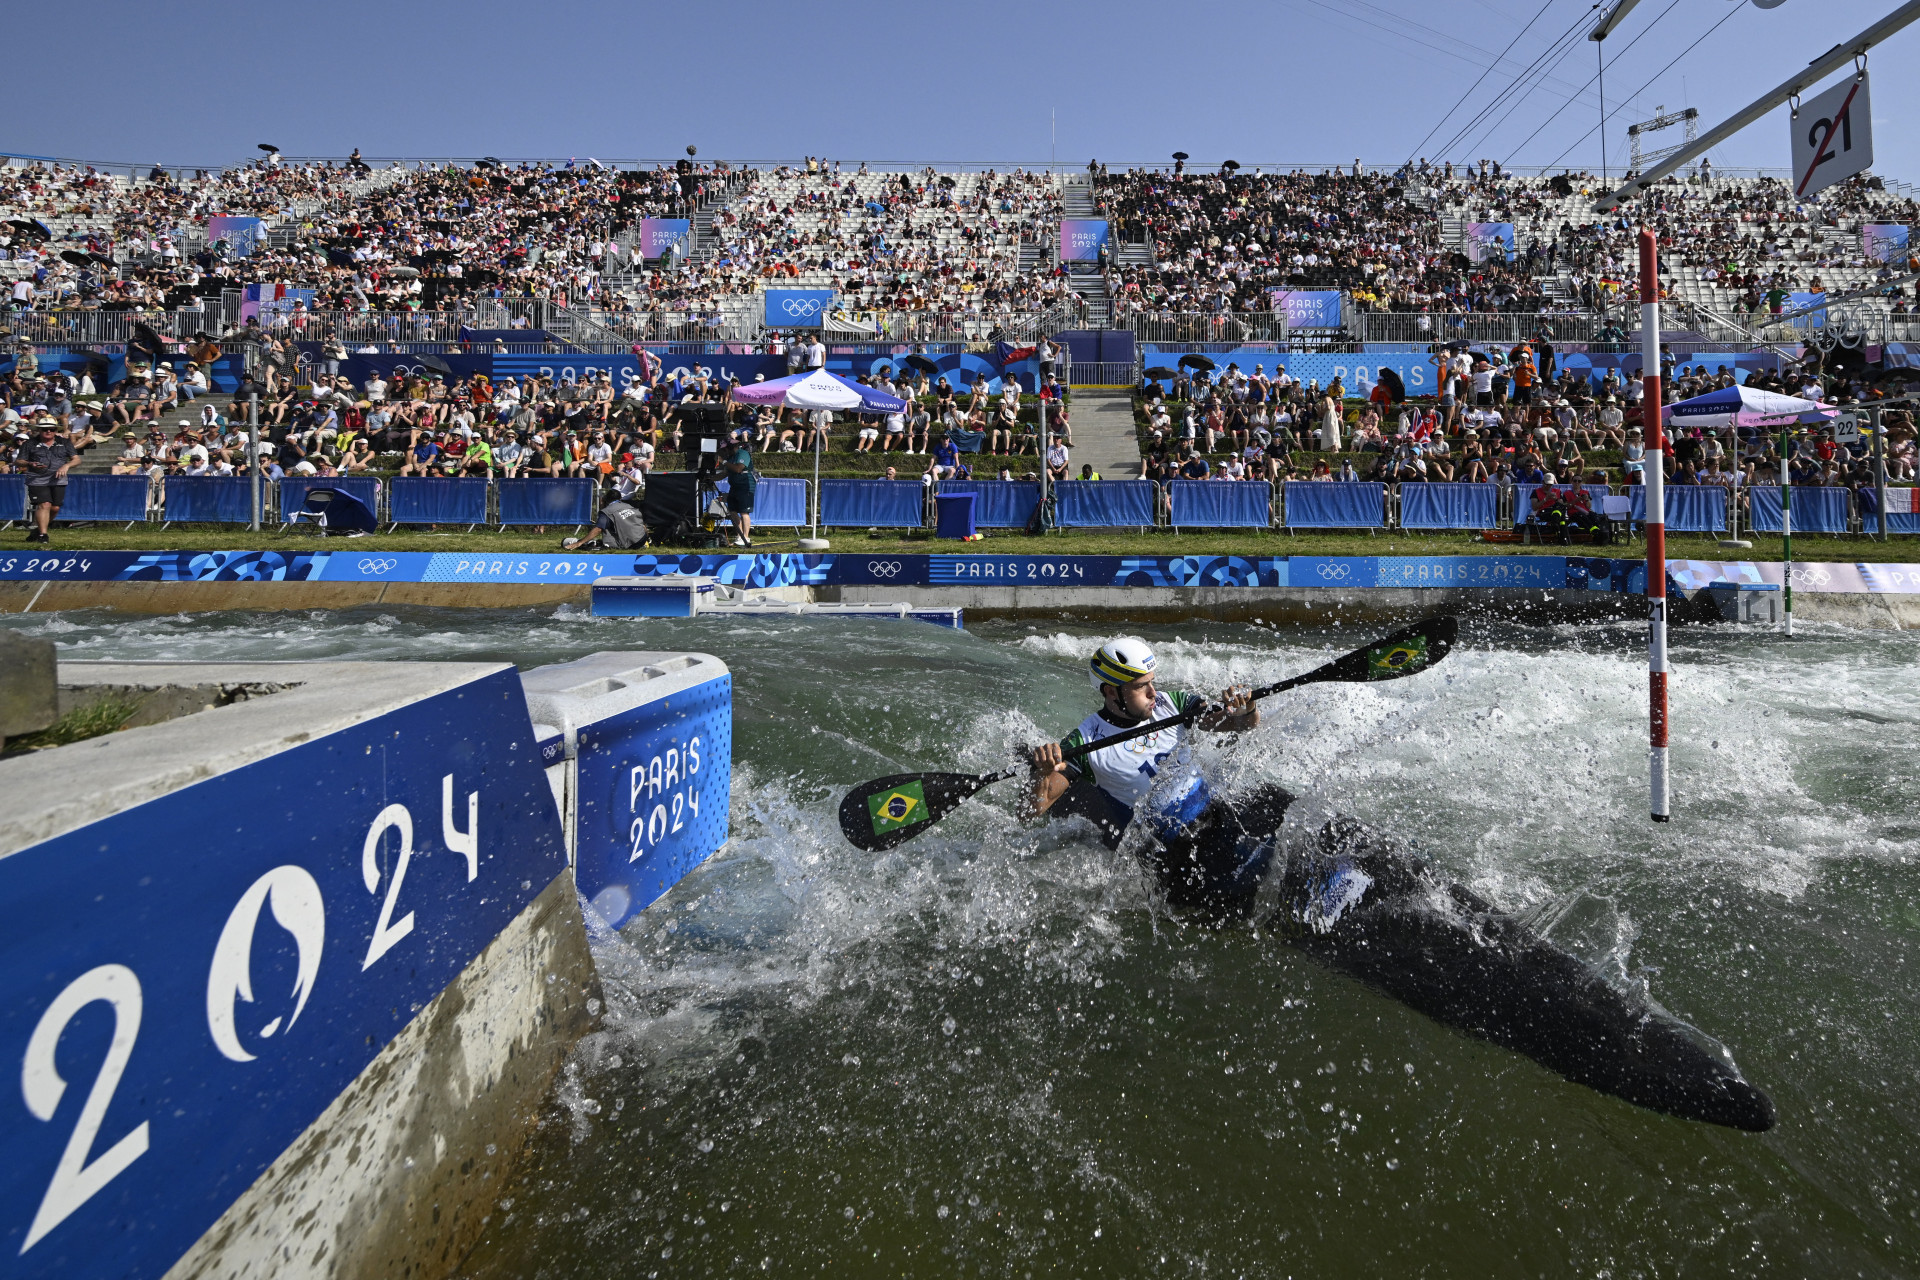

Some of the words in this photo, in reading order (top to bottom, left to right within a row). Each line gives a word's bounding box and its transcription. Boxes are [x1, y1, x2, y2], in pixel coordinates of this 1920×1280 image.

[1808, 104, 1851, 166] 21
[850, 312, 873, 322] TIM
[1288, 310, 1323, 319] 2024
[1838, 421, 1854, 436] 22
[22, 558, 92, 573] 2024
[537, 562, 604, 577] 2024
[1027, 563, 1084, 579] 2024
[1478, 565, 1541, 581] 2024
[629, 787, 700, 865] 2024
[20, 773, 479, 1256] 2024
